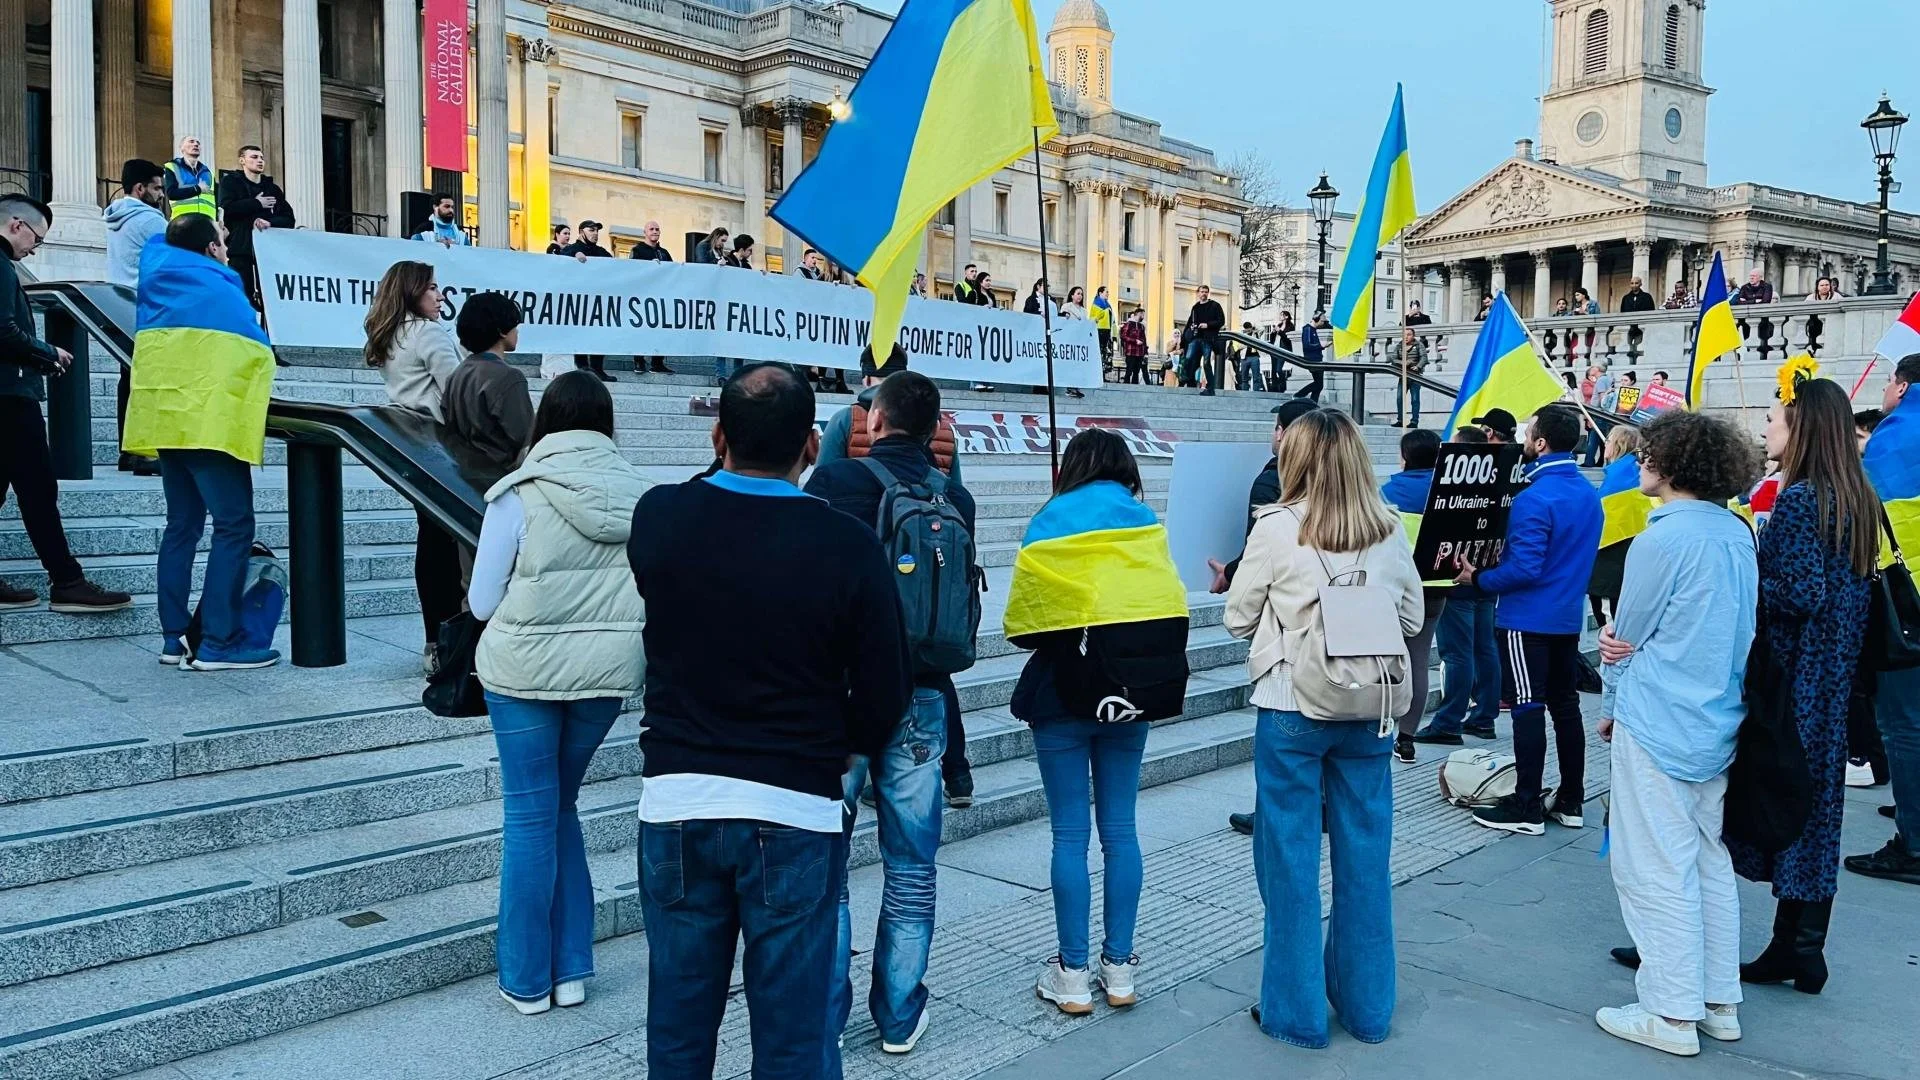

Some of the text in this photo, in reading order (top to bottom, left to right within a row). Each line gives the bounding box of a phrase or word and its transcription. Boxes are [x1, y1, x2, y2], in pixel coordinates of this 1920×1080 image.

[438, 19, 449, 102] NATIONAL
[450, 22, 463, 106] GALLERY
[275, 273, 342, 304] WHEN
[347, 279, 381, 305] TH
[629, 296, 716, 330] SOLDIER
[727, 302, 791, 341] FALLS,
[797, 312, 850, 348] PUTIN
[900, 325, 944, 356] COME
[947, 331, 973, 360] FOR
[977, 325, 1013, 364] YOU
[1016, 340, 1049, 359] LADIES
[1060, 346, 1090, 362] GENTS!
[1440, 453, 1498, 485] 1000s
[1434, 496, 1446, 510] in
[1476, 517, 1488, 530] to
[1433, 539, 1506, 571] PUTIN
